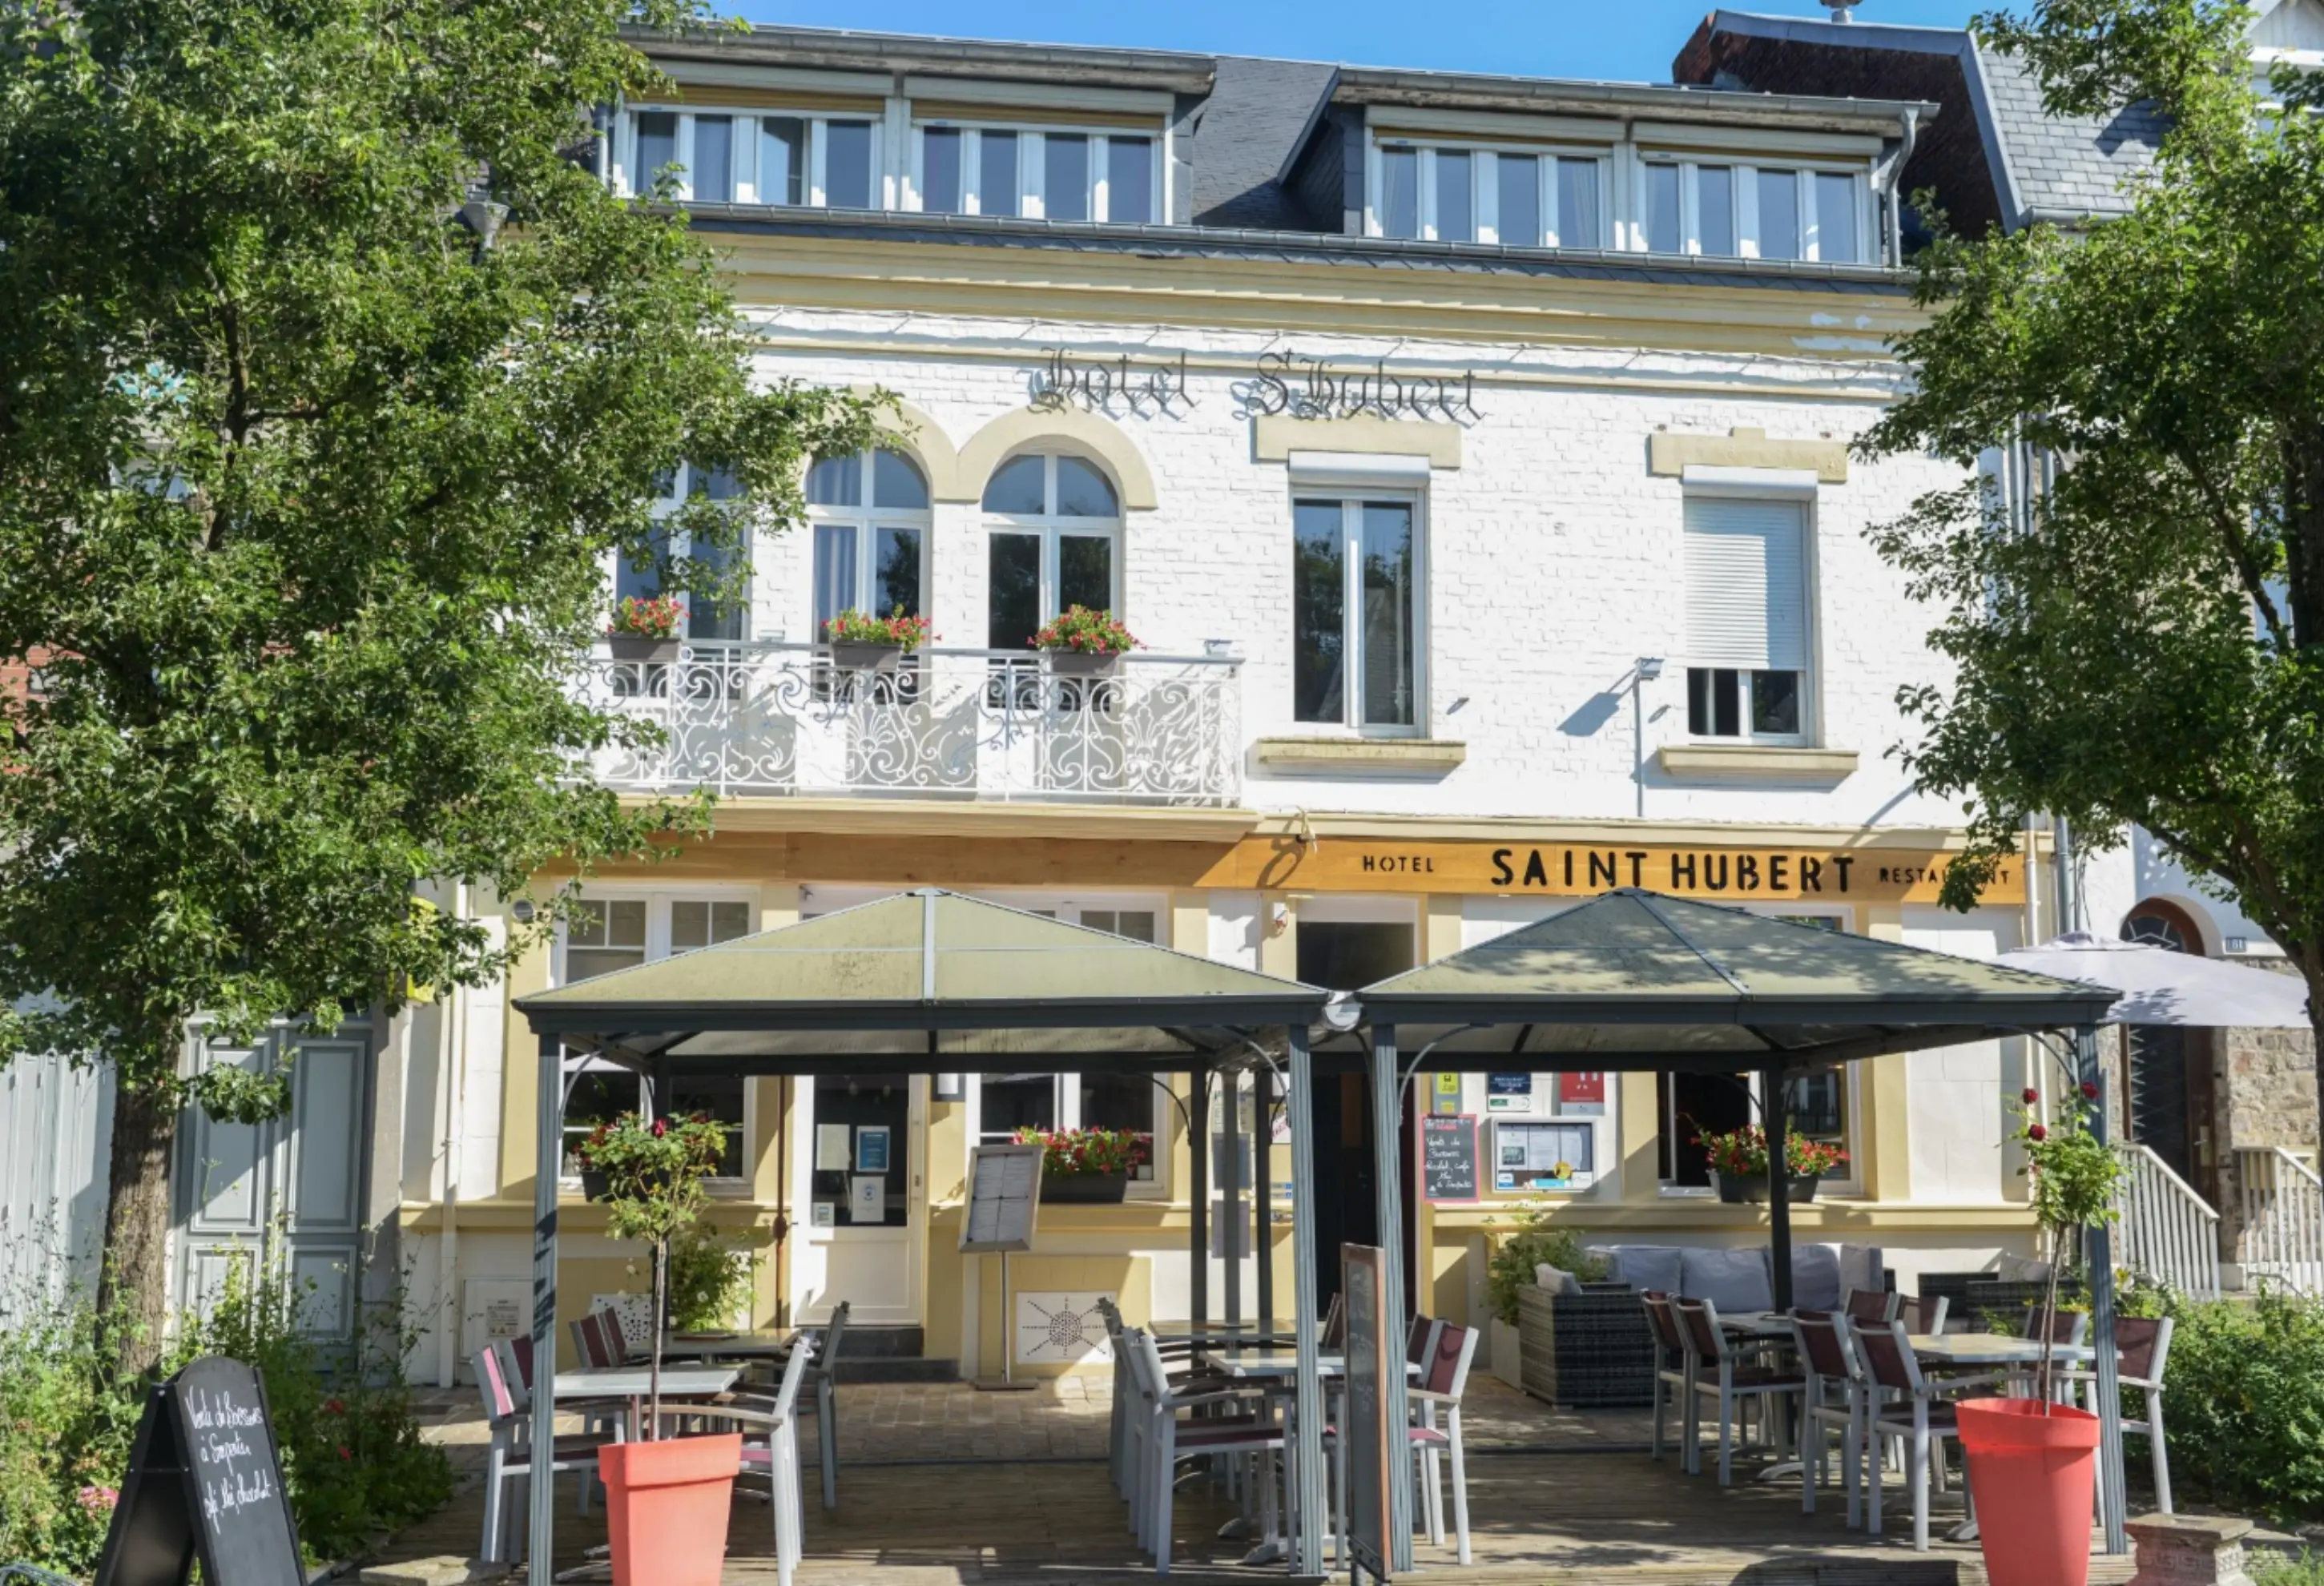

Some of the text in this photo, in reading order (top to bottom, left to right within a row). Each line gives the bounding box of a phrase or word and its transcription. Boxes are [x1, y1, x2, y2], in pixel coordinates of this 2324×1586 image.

[1363, 848, 2010, 893] HOTEL SAINT HUBERT RESTANT
